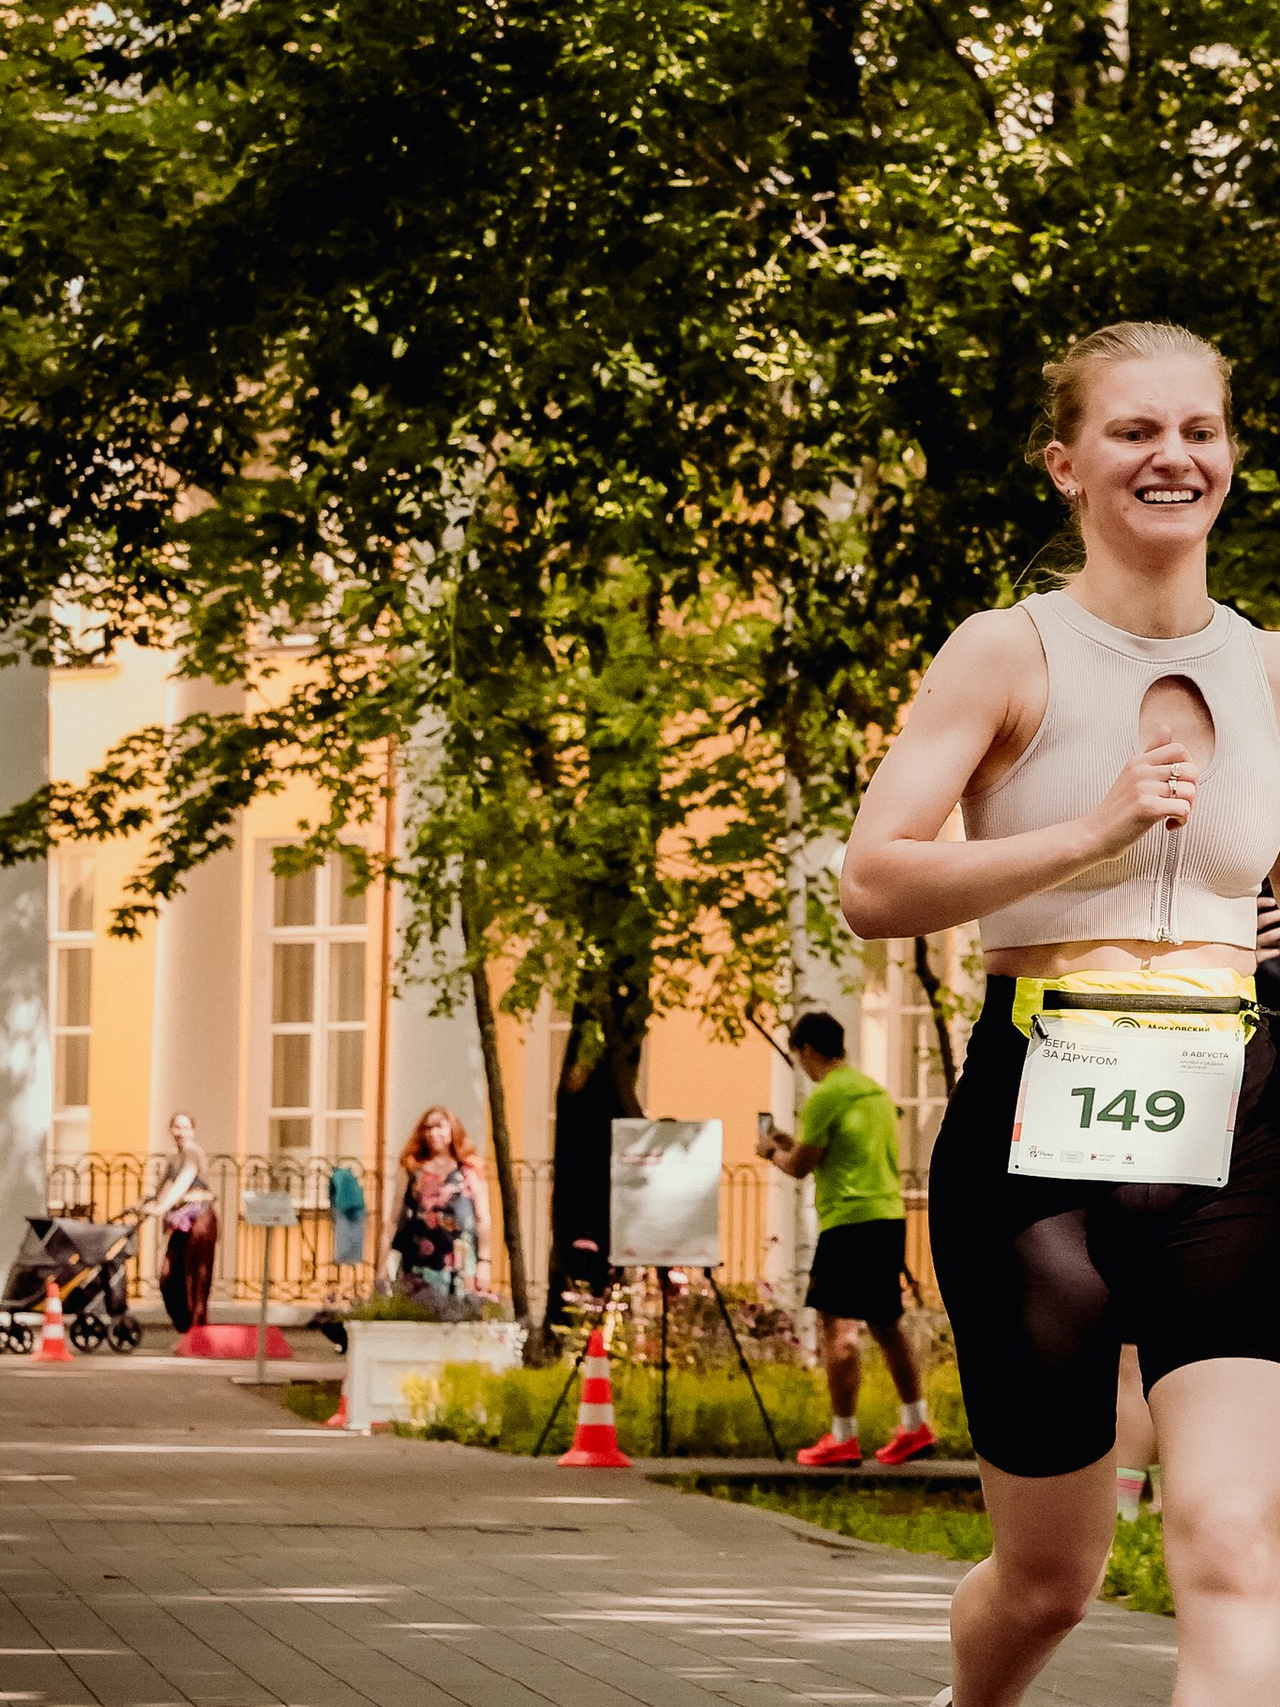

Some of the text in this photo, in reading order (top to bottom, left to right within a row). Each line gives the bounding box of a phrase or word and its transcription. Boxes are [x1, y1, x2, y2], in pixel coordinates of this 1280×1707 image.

[1044, 1038, 1076, 1050] БЕГИ
[1042, 1049, 1118, 1066] ЗА ДРУГОМ
[1190, 1051, 1229, 1059] АВГУСТА
[1070, 1086, 1186, 1133] 149
